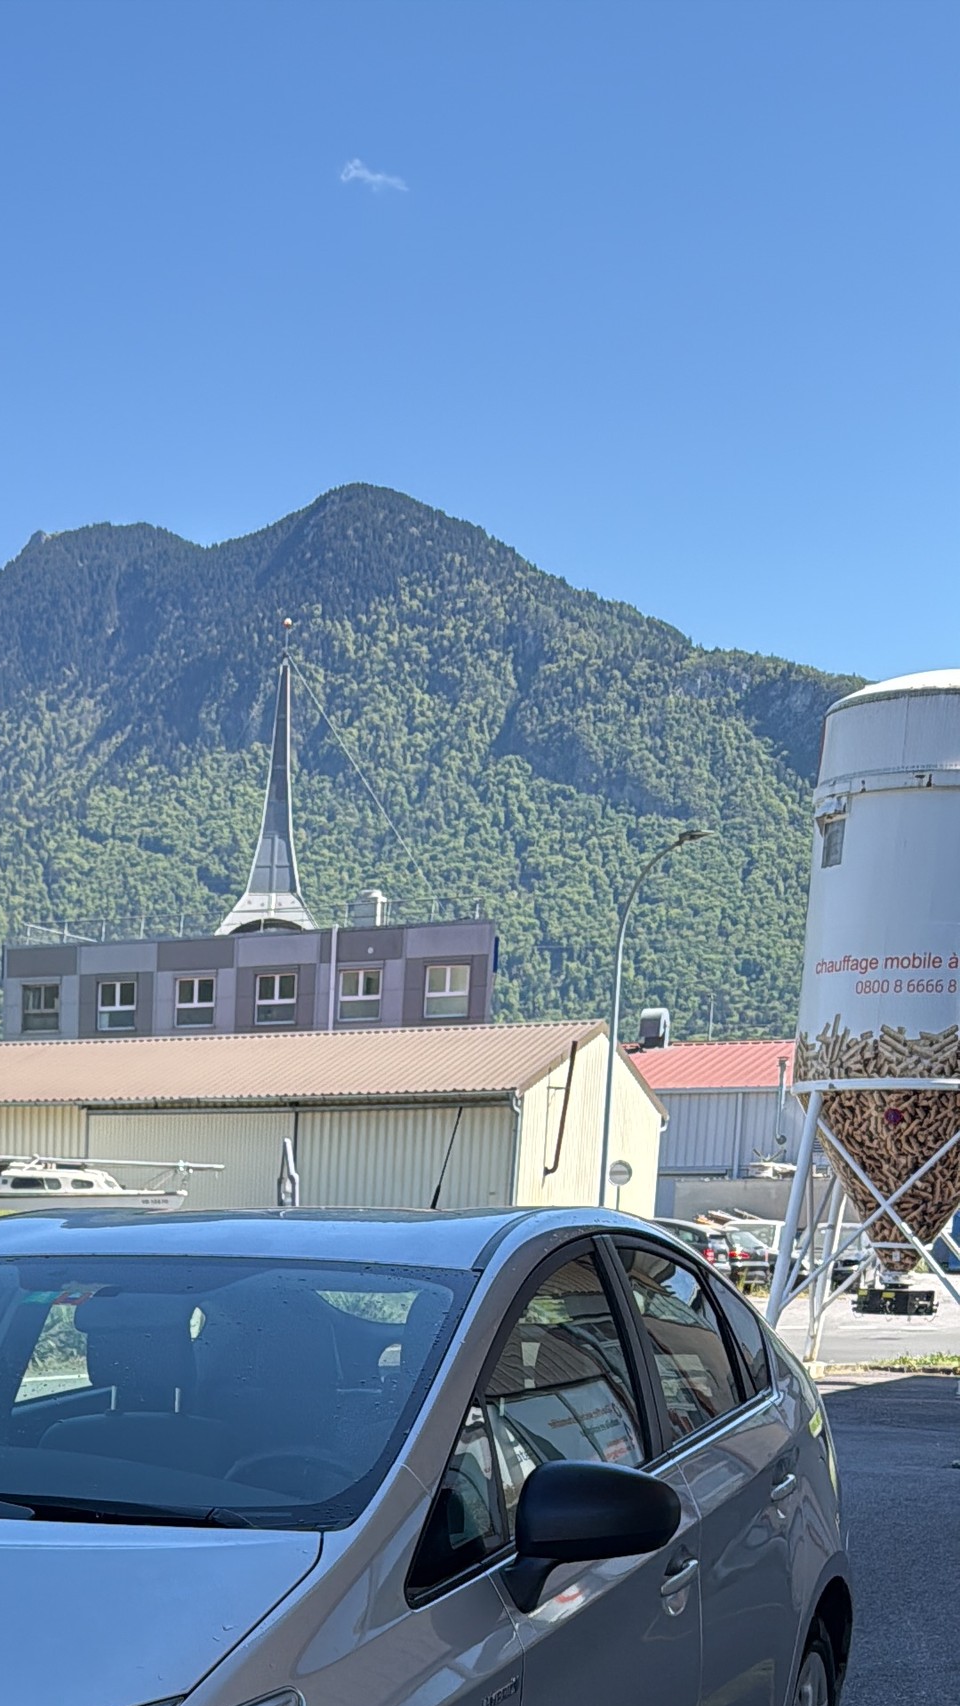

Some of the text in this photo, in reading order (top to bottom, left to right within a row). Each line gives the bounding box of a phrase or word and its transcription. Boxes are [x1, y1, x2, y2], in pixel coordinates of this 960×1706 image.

[815, 952, 959, 975] chauffage mobile à
[855, 979, 957, 994] 0800 8 6666 8
